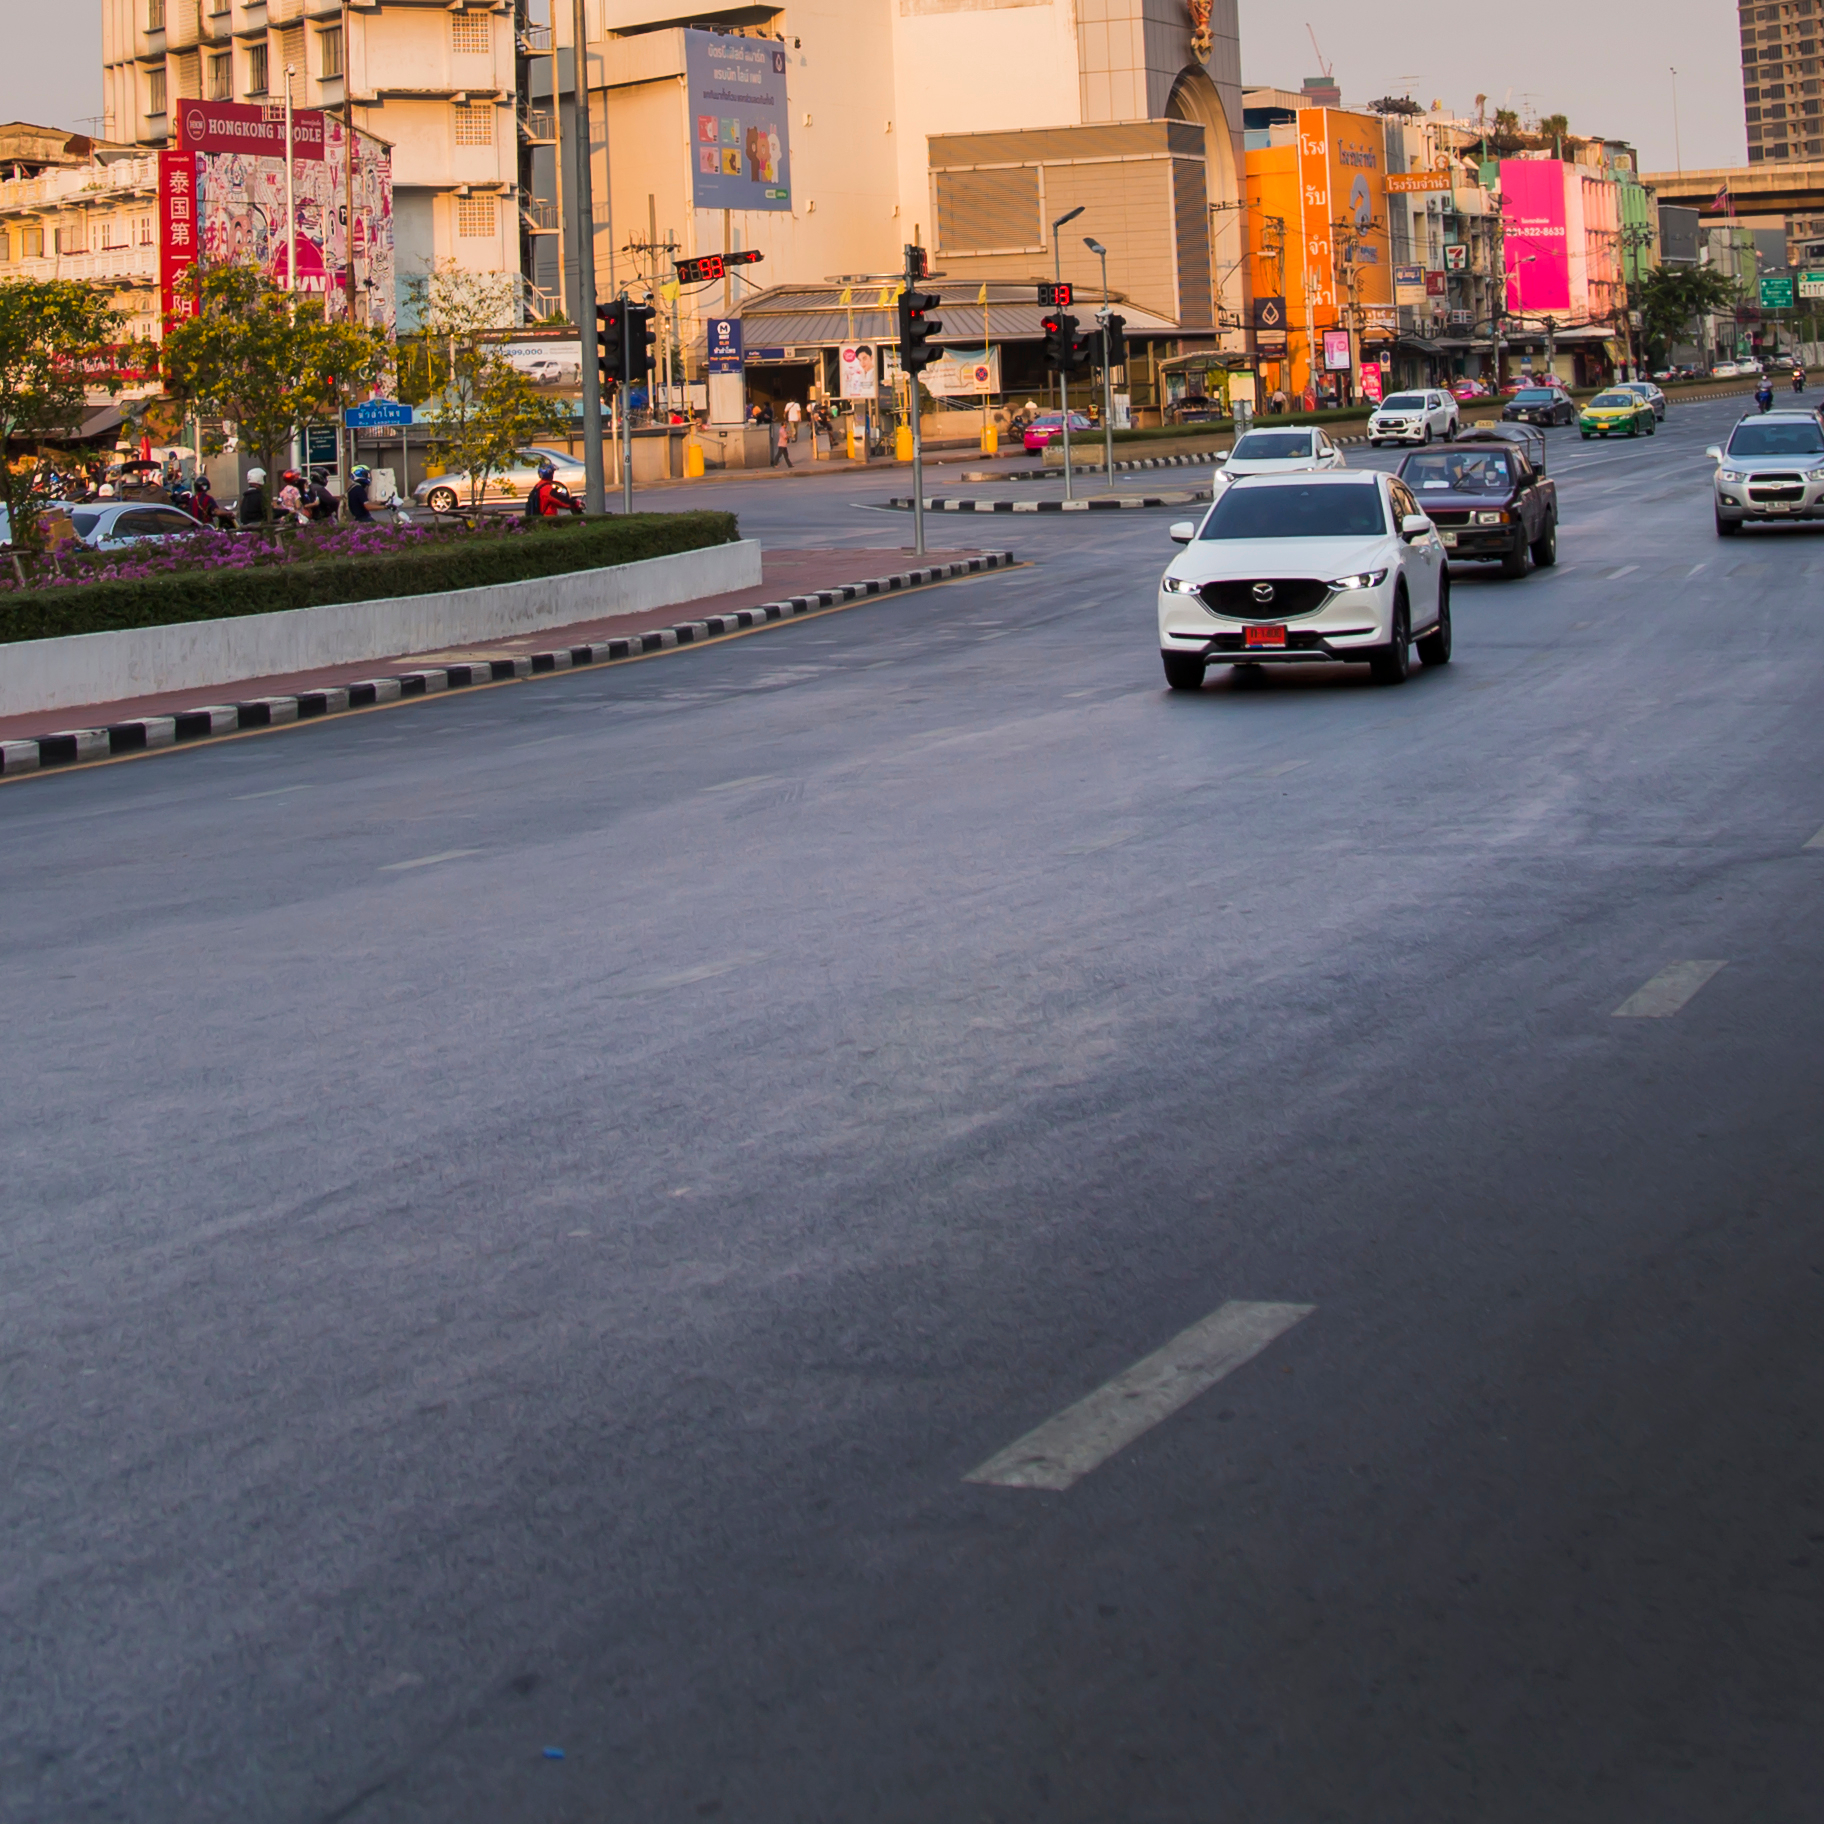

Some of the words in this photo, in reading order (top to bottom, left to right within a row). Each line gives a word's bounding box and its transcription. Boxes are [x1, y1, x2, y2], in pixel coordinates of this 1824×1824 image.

[208, 118, 274, 139] HONGKONG
[277, 125, 322, 143] NODLE
[1301, 133, 1325, 156] โรง
[1387, 175, 1450, 192] โรงรับจำนำ
[1305, 184, 1326, 206] รับ
[1308, 234, 1328, 256] จำ
[699, 256, 724, 280] 93
[1054, 286, 1070, 305] 13
[358, 406, 401, 420] หัวลำโพง
